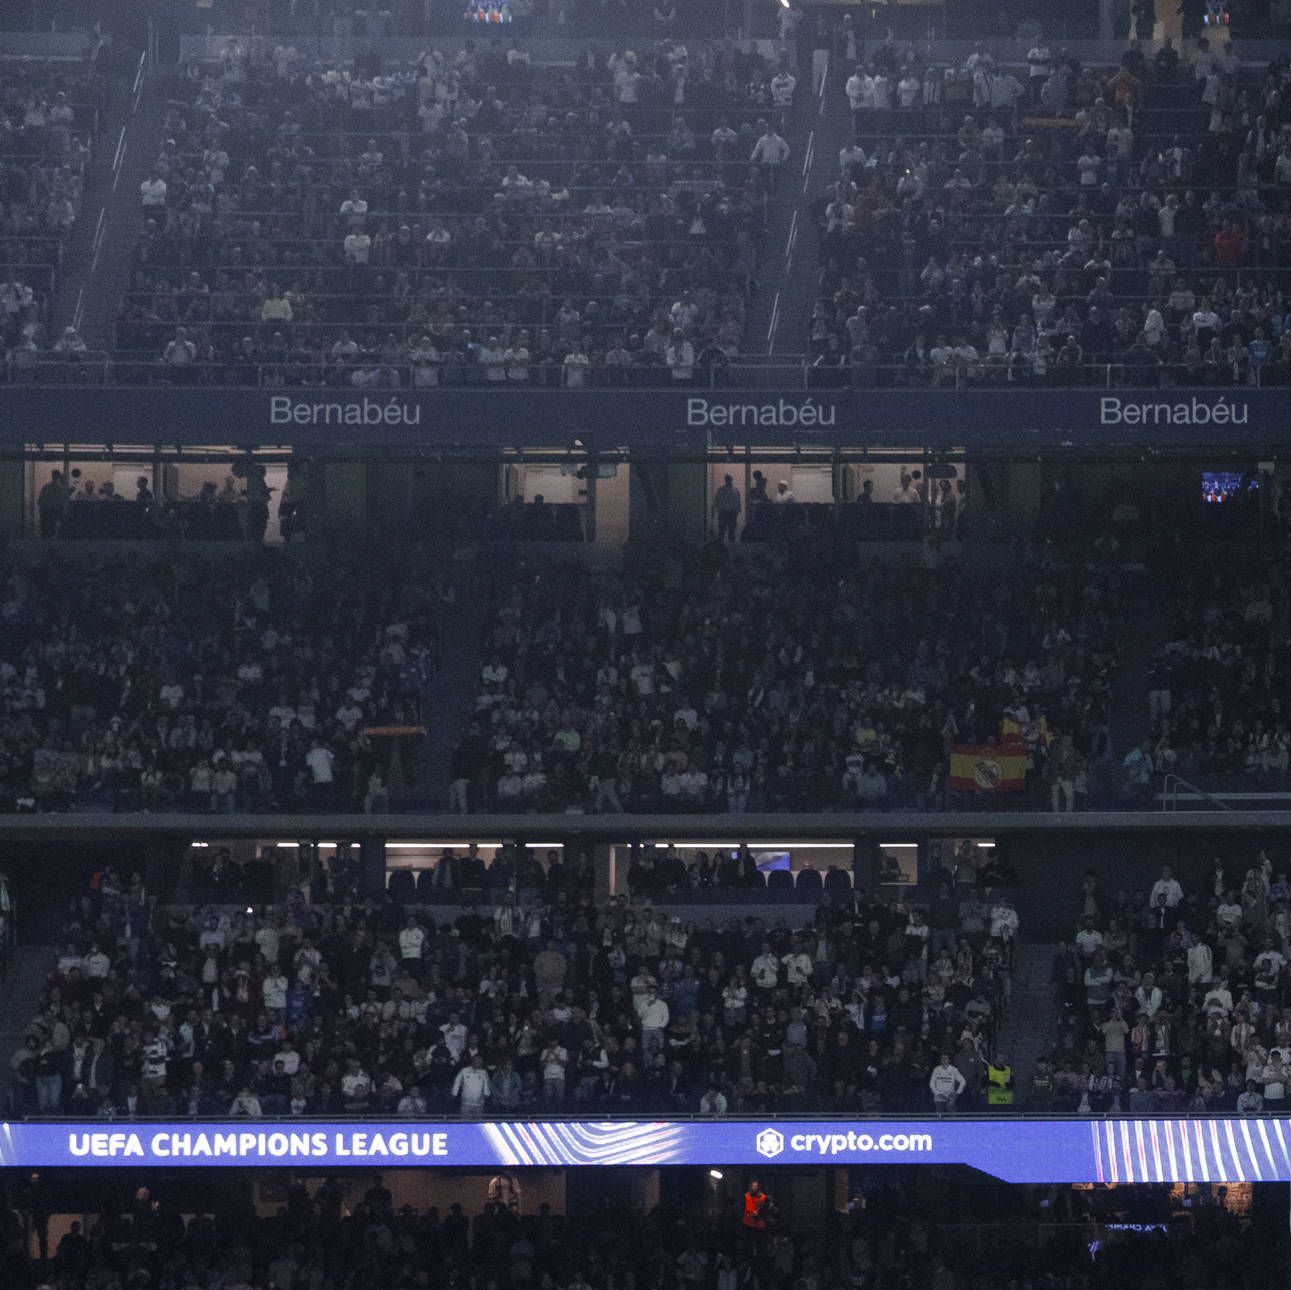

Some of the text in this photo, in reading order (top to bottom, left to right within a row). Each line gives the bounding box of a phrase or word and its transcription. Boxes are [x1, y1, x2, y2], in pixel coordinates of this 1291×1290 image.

[270, 397, 420, 425] Bernabéu
[687, 398, 836, 425] Bernabéu
[1100, 396, 1248, 424] Bernabéu
[69, 1133, 448, 1156] UEFA CHAMPIONS LEAGUE
[791, 1131, 932, 1154] crypto.com
